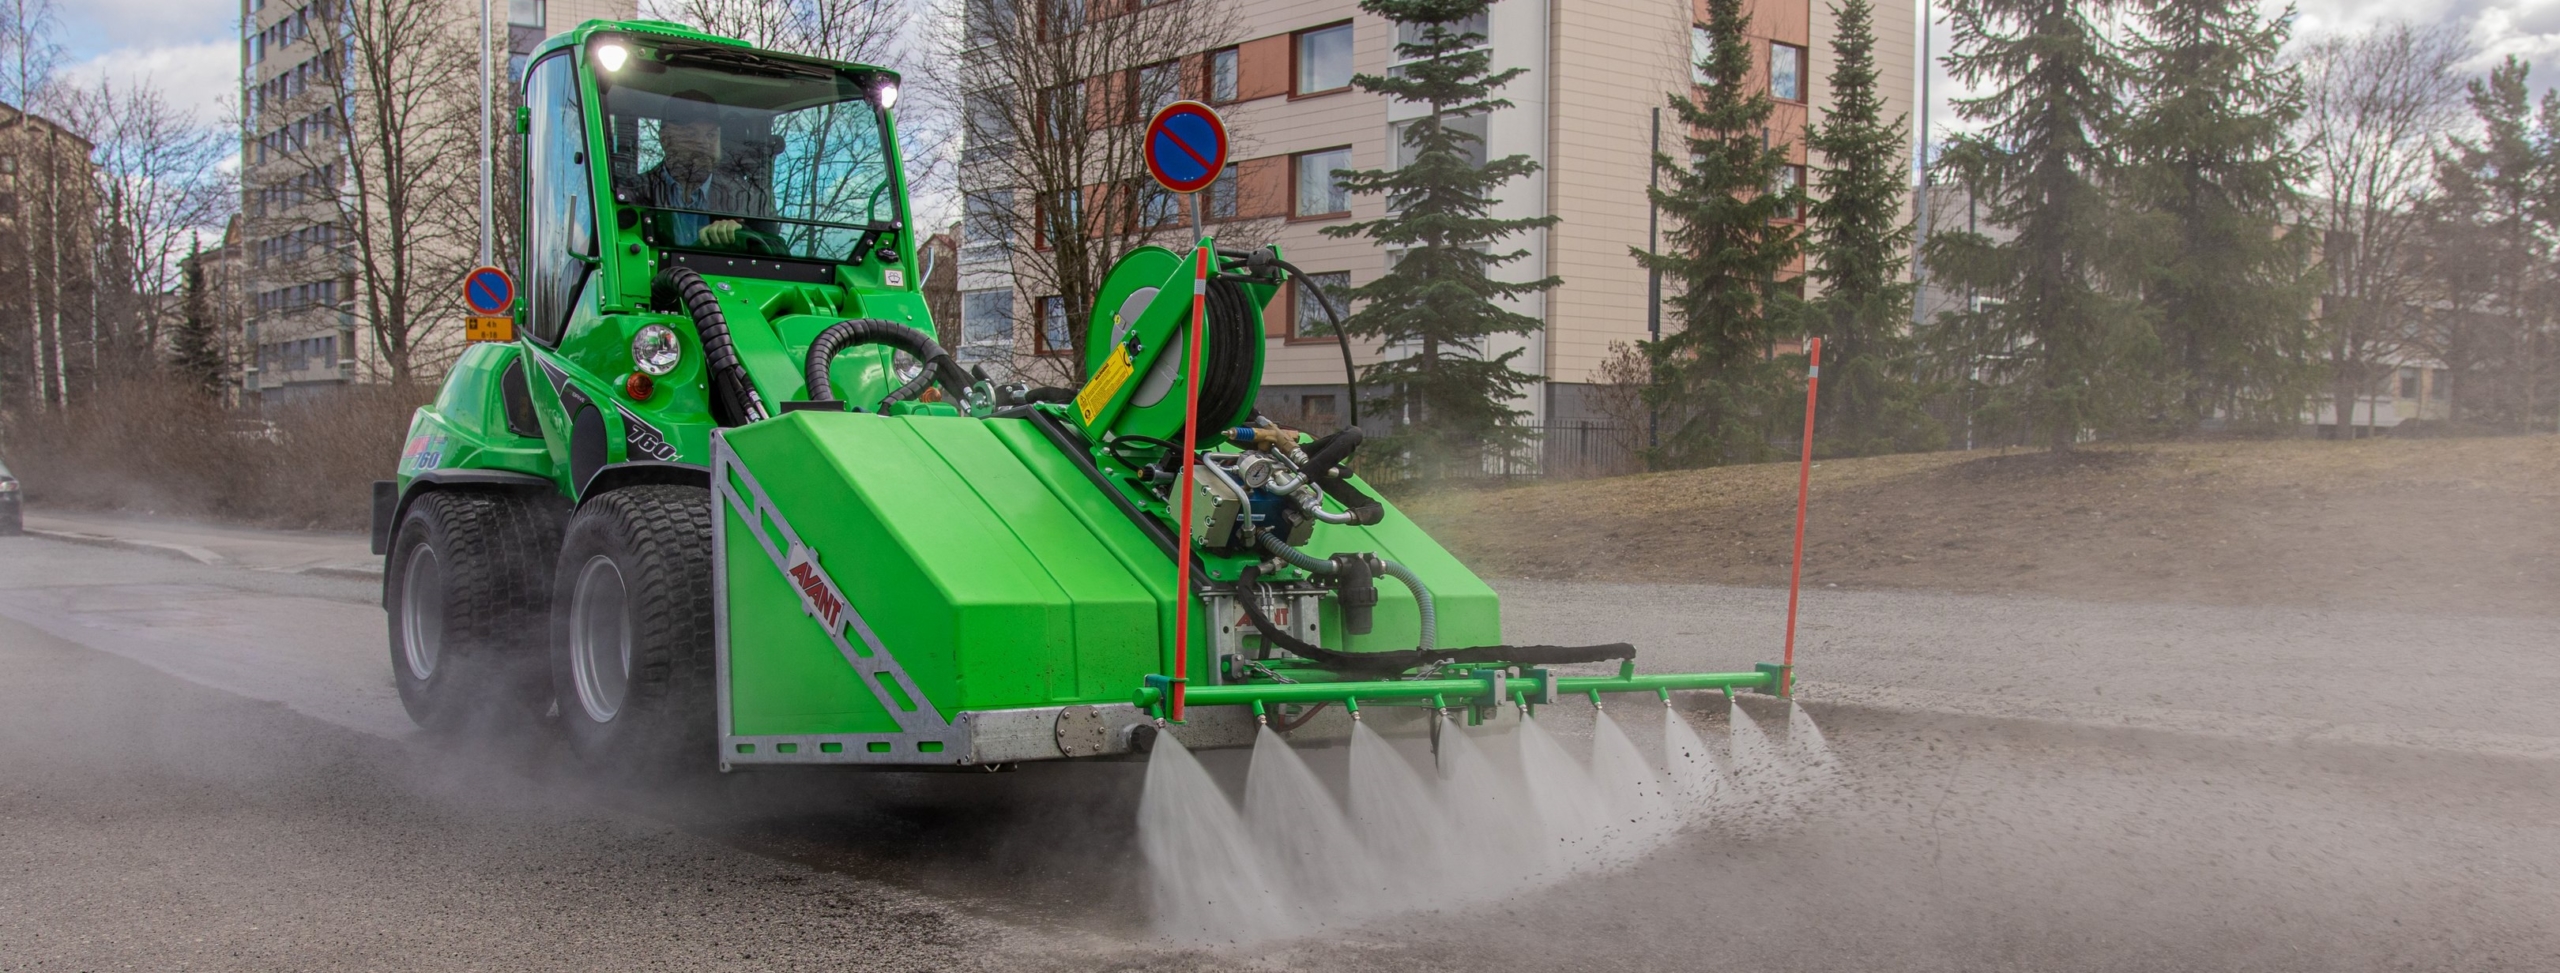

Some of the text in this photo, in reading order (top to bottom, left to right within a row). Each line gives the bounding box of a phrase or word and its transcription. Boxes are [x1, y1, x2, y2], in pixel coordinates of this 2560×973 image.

[627, 424, 677, 461] 760
[411, 451, 441, 470] 760
[789, 561, 842, 629] AVANT
[1235, 607, 1289, 627] ANT
